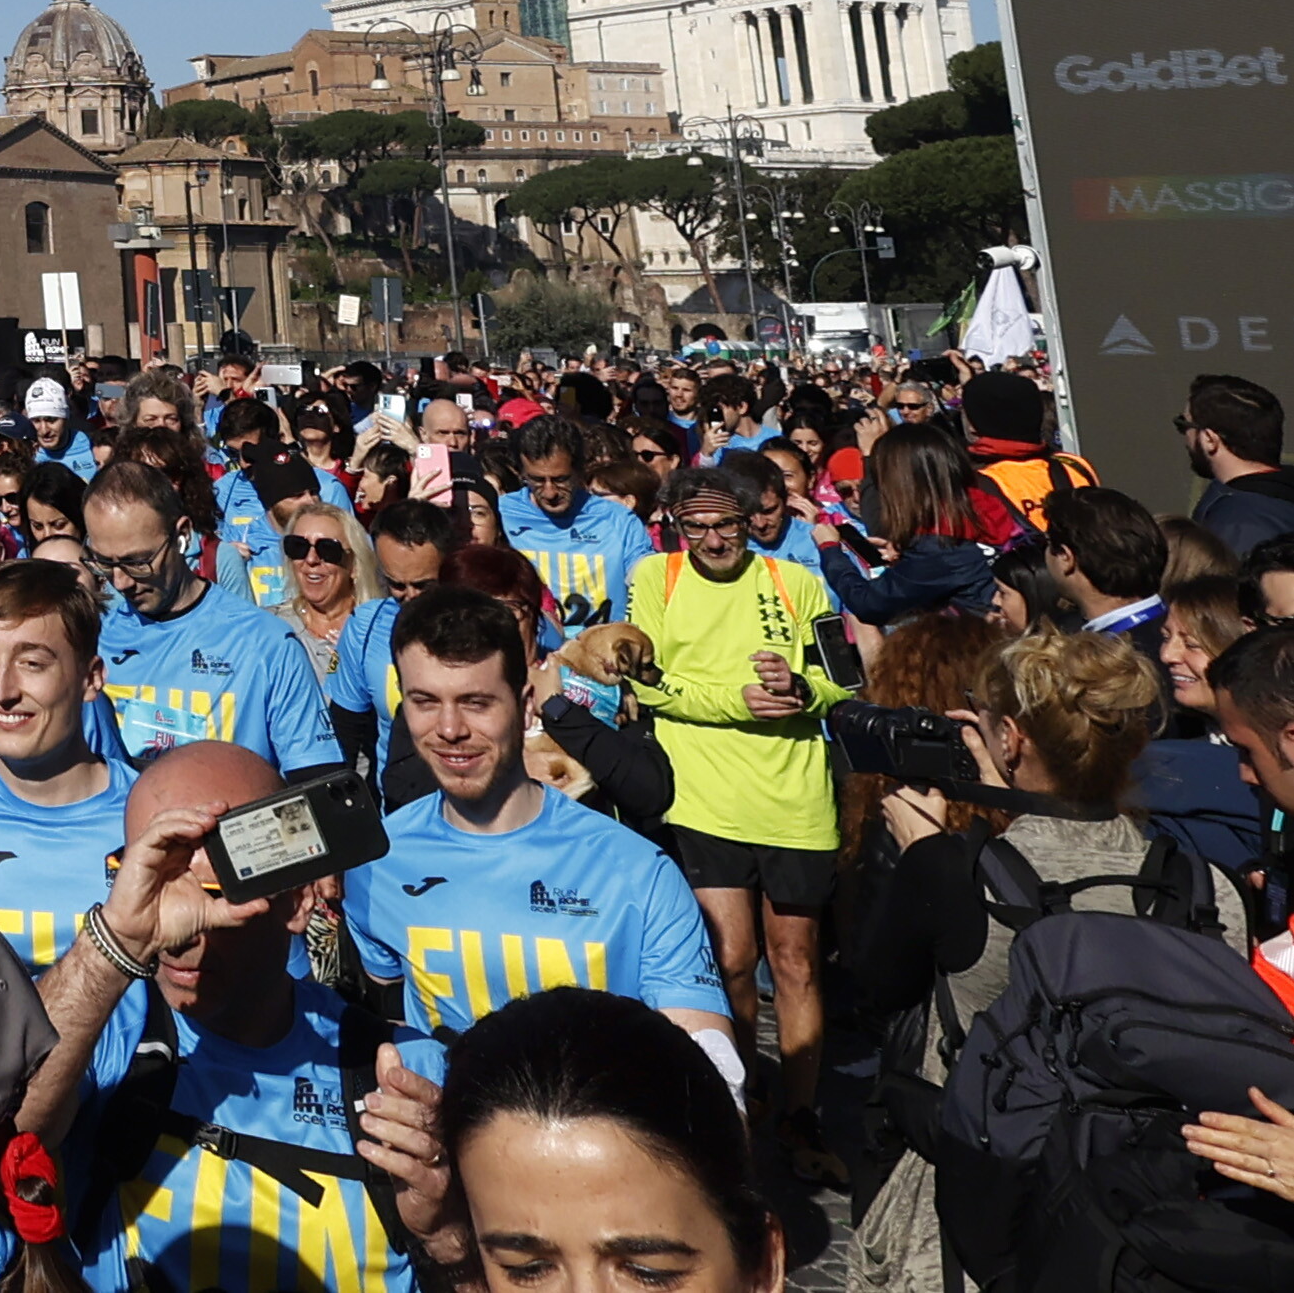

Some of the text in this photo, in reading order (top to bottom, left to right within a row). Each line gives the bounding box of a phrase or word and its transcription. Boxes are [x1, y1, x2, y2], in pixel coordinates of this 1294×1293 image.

[1053, 46, 1288, 95] GoldBet
[558, 896, 590, 906] ROME
[407, 926, 608, 1028] FUN
[293, 1113, 327, 1128] acea
